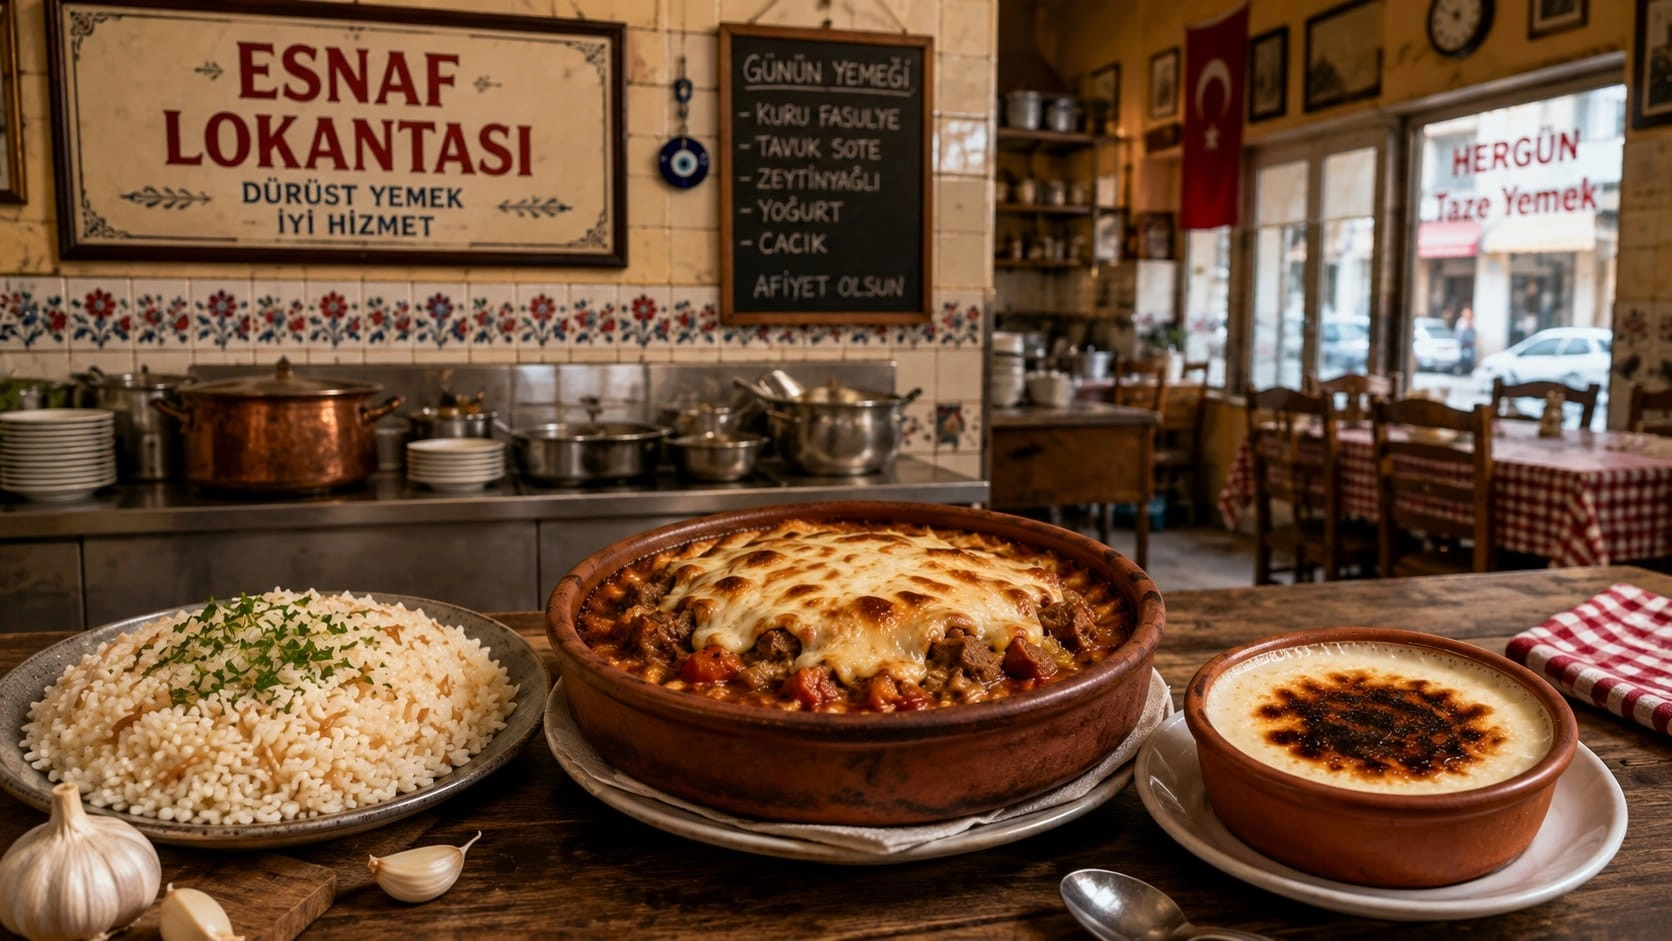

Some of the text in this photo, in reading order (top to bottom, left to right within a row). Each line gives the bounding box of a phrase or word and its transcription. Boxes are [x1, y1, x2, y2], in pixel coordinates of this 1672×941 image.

[236, 41, 460, 109] ESNAF
[743, 53, 912, 88] GÜNÜN YEMEĞİ
[756, 101, 811, 127] KURU
[819, 104, 900, 131] FASULYE
[163, 110, 533, 177] LOKANTASI
[755, 135, 822, 159] TAVUK
[831, 137, 882, 161] SOTE
[1451, 125, 1581, 177] HERGÜN
[242, 178, 464, 209] DÜRÜST YEMEK
[756, 164, 881, 192] ZEYTİNYAĞLI
[757, 195, 845, 223] YOĞURT
[1435, 177, 1600, 222] Taze Yemek
[278, 208, 435, 237] İYİ HİZMET
[758, 231, 829, 255] CACIK
[753, 269, 905, 301] AFİYET OLSUN
